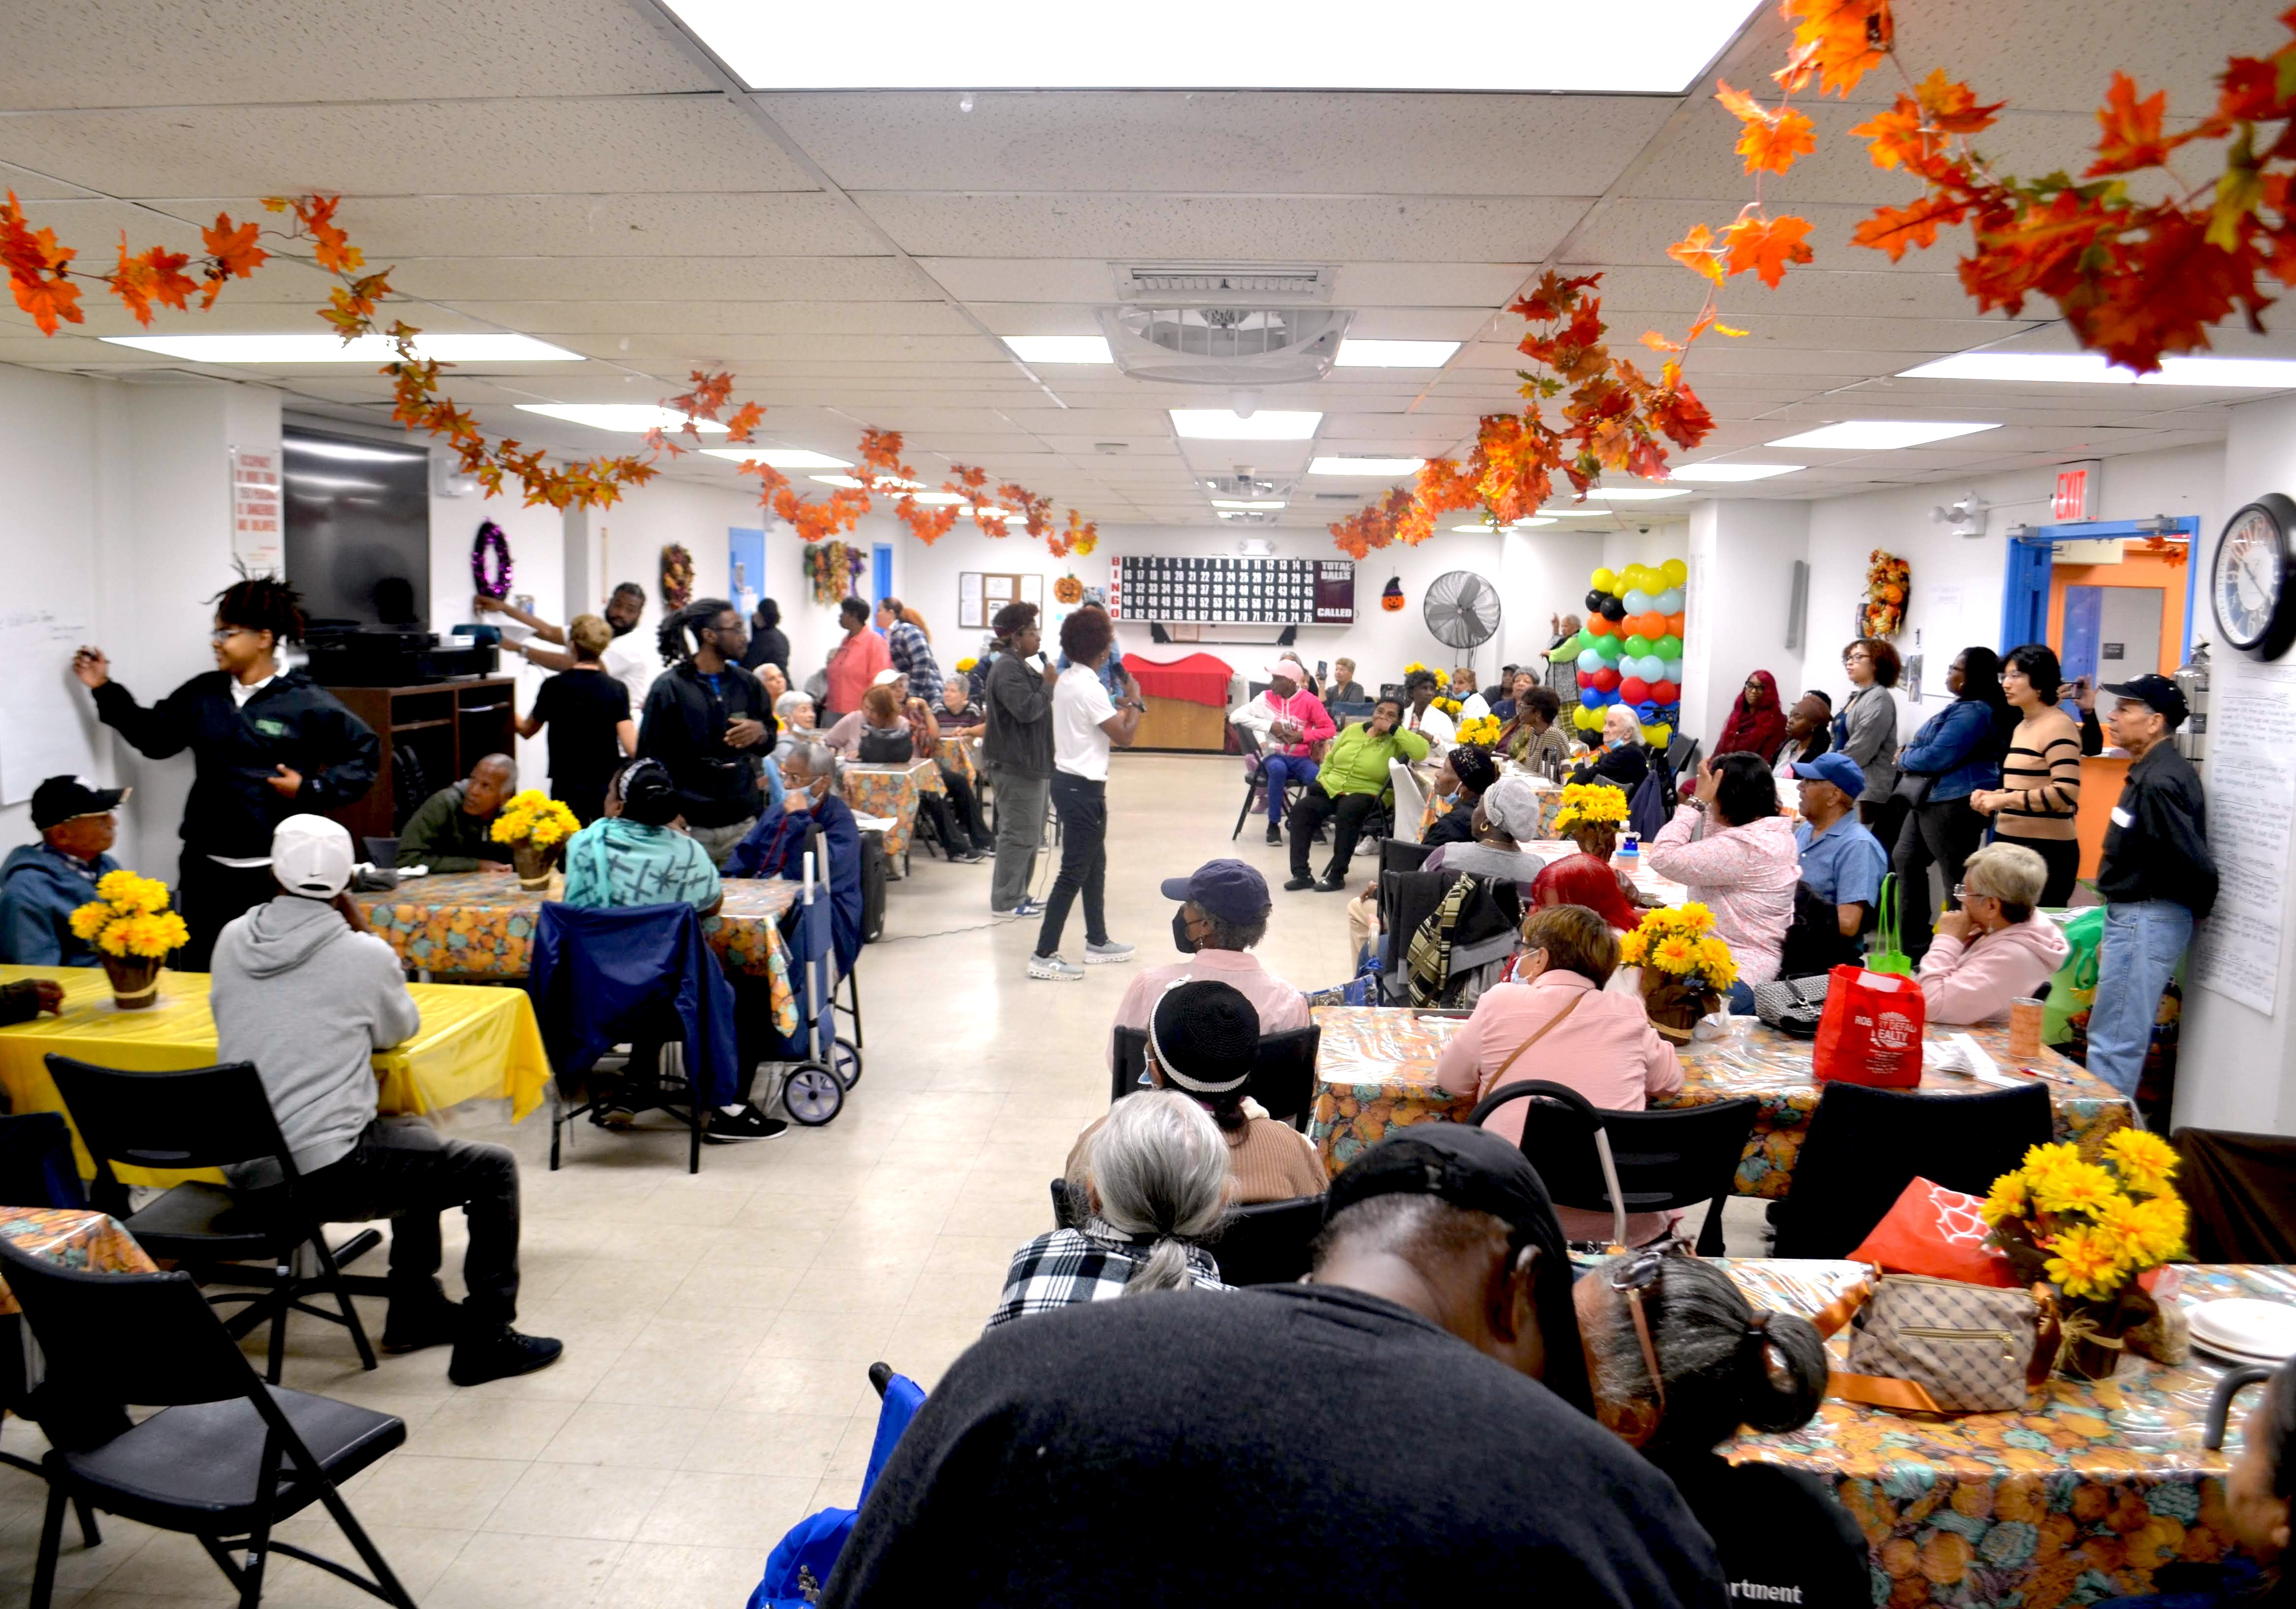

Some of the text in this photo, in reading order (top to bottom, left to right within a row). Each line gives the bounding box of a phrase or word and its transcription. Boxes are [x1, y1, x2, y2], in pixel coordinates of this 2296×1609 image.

[2055, 470, 2087, 520] EXIT
[1126, 557, 1313, 570] 1 2 3 4 5 6 7 8 9 10 11 12 13 14 15
[1322, 561, 1352, 571] TOTAL
[1124, 570, 1313, 584] 16 17 18 19 20 21 22 23 24 25 26 27 28 29 30
[1321, 571, 1351, 580] BALLS
[1124, 583, 1313, 596] 31 32 33 34 35 36 37 38 39 40 41 42 43 44 45
[1123, 595, 1313, 609] 46 47 48 49 50 51 52 53 54 55 56 57 58 59 60
[1123, 609, 1313, 622] 61 62 63 64 65 66 67 68 69 70 71 72 73 74 75
[1317, 608, 1352, 617] CALLED
[1724, 1579, 1803, 1605] rtment
